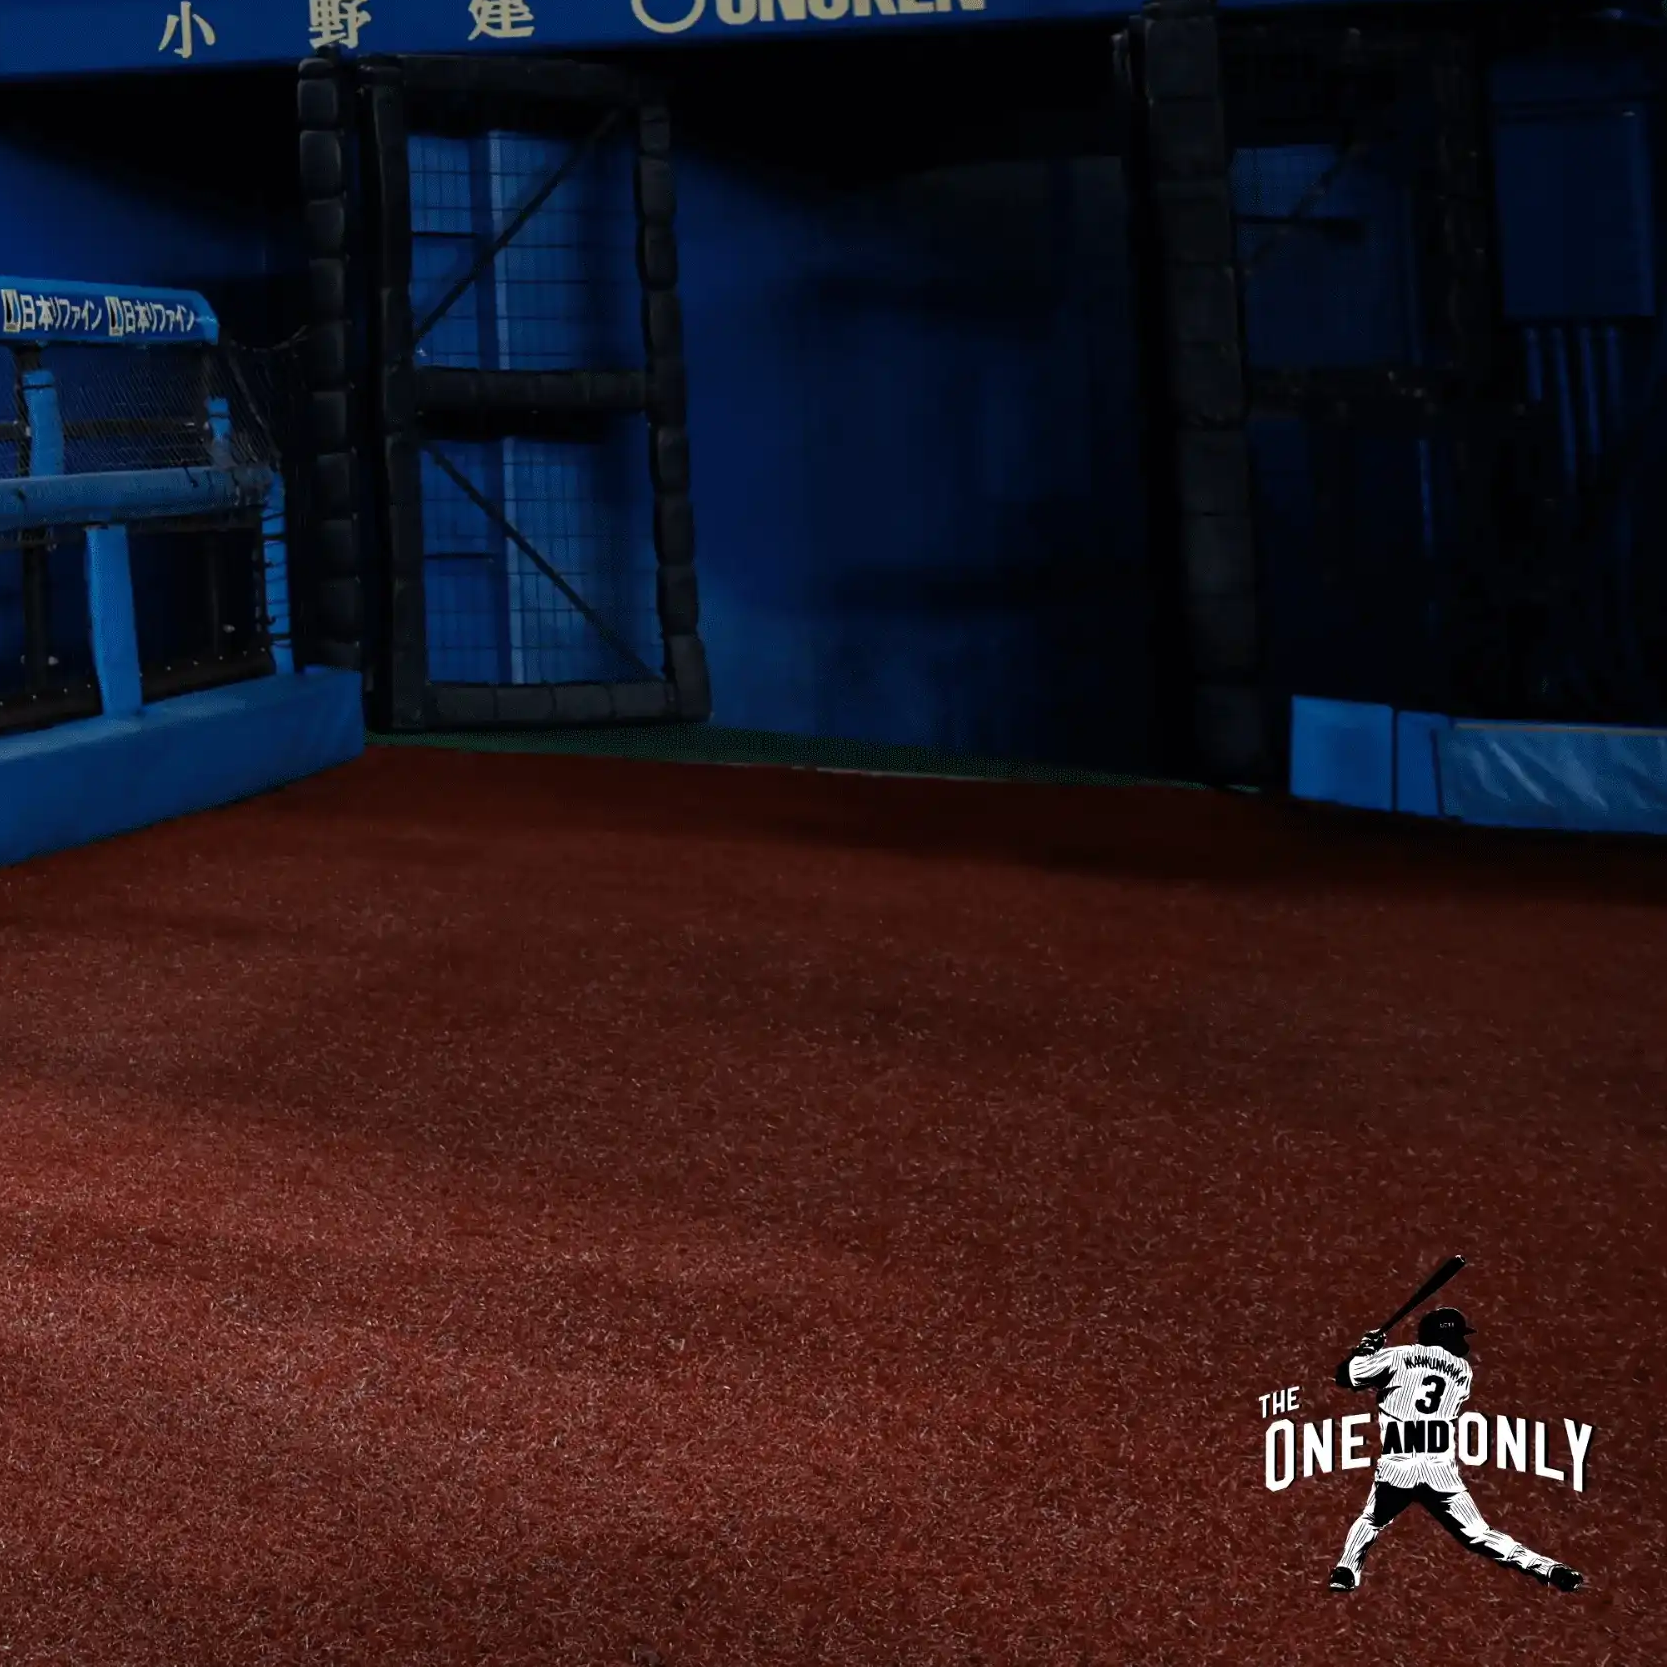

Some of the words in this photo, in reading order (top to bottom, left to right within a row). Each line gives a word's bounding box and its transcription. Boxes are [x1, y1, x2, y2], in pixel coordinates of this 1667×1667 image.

[21, 294, 104, 333] 日本リファイン
[122, 298, 197, 334] 日本リファイン
